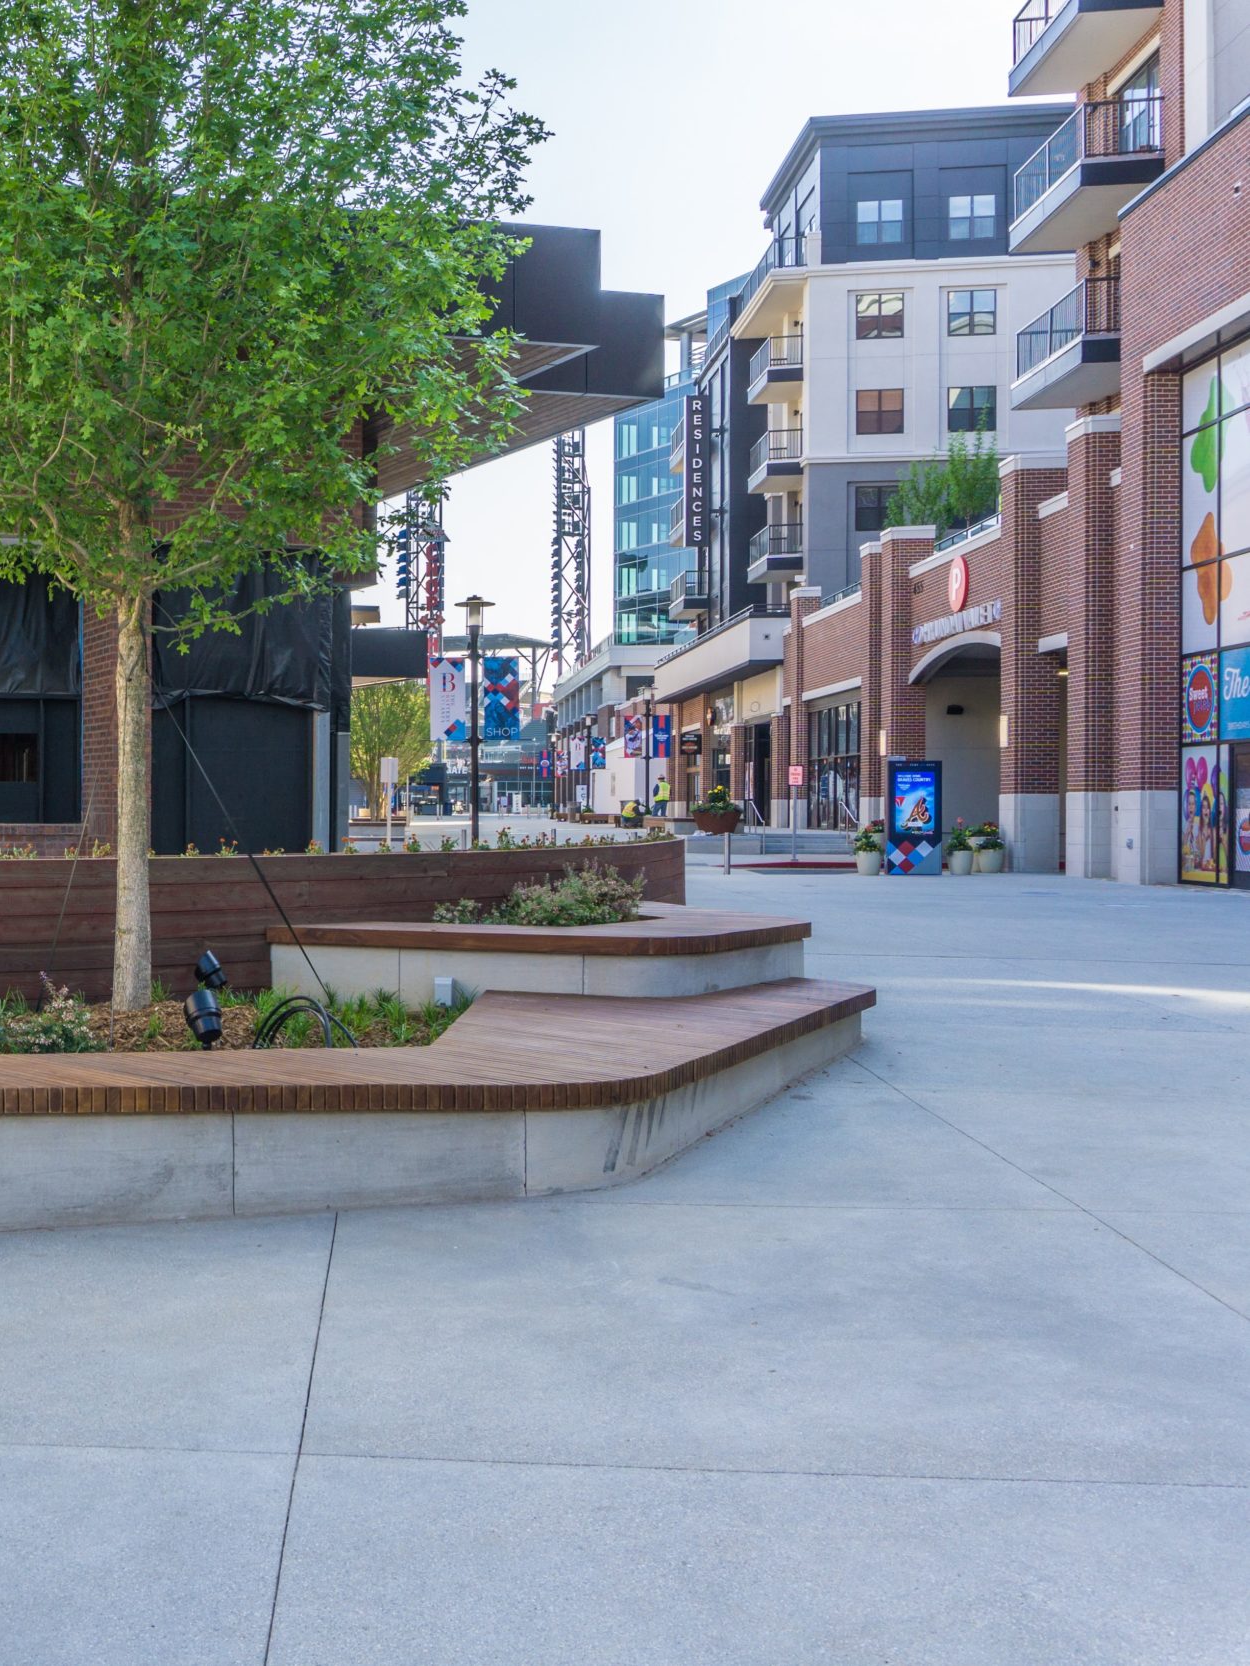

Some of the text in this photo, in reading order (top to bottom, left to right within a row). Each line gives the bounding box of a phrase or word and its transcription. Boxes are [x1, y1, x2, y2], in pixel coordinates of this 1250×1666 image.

[692, 399, 703, 541] RESIDENCES
[426, 543, 440, 611] CHOP
[952, 567, 962, 600] P
[1189, 686, 1208, 701] Sweet
[1223, 667, 1250, 701] The
[486, 727, 519, 737] SHOP
